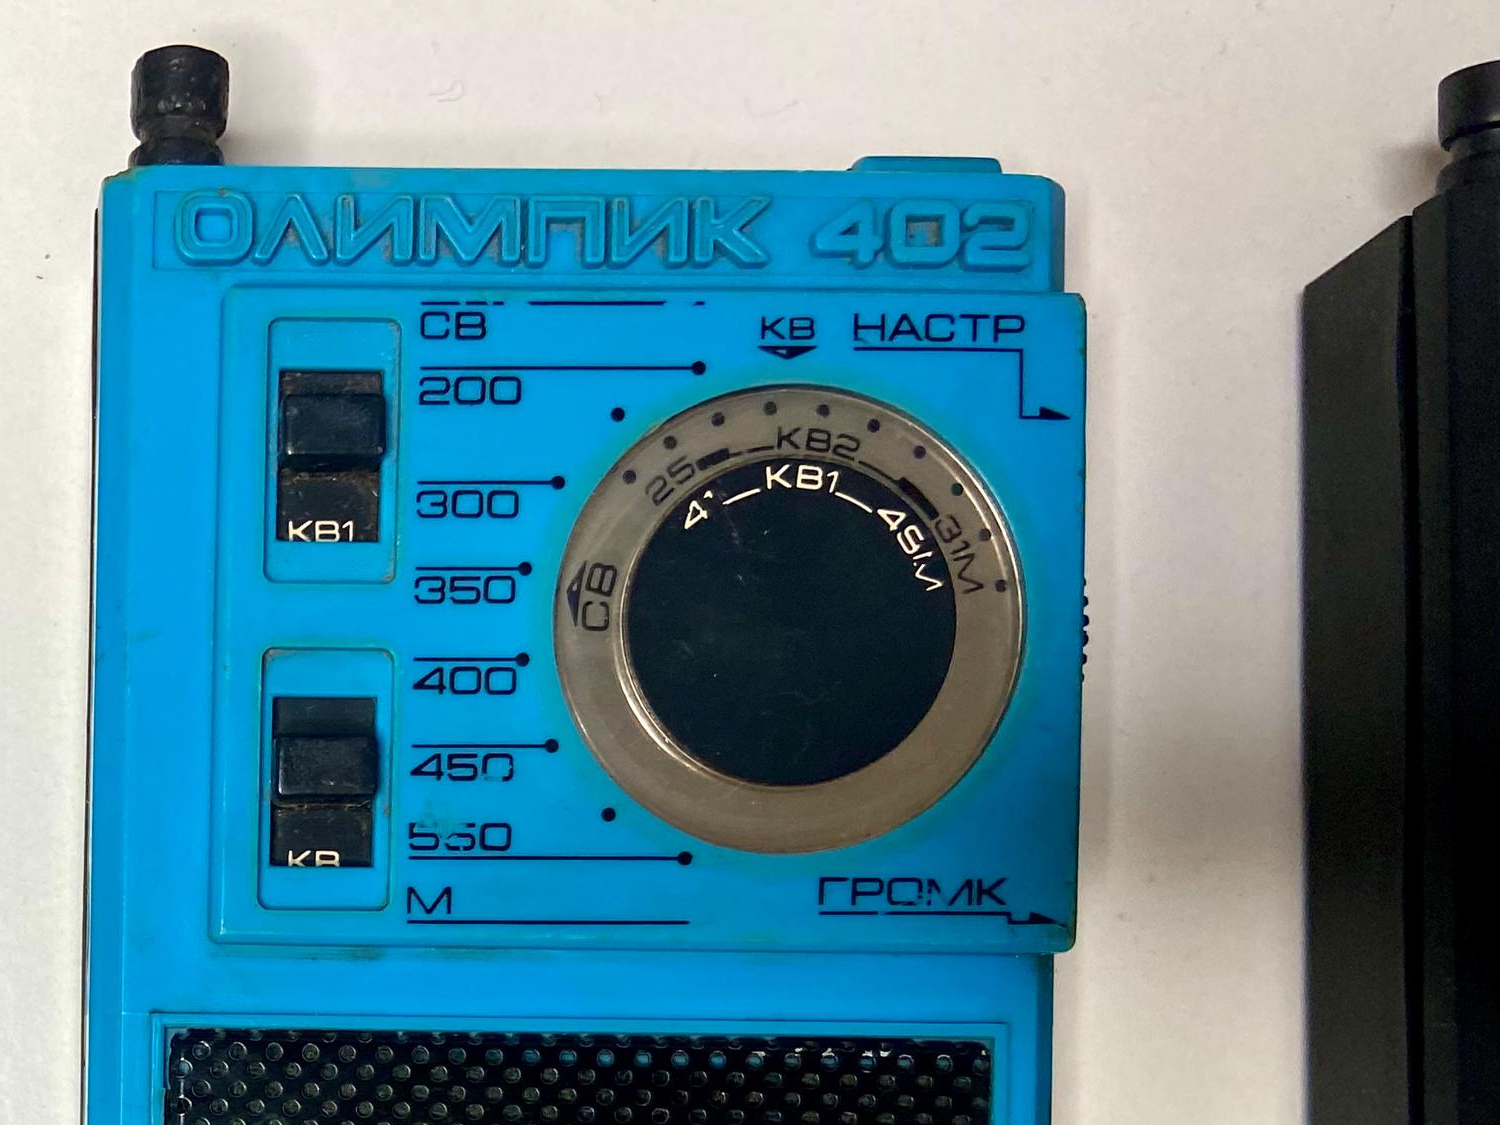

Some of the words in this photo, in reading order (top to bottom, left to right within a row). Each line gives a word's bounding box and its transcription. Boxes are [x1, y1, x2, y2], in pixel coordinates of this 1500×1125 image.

[174, 189, 773, 268] ОЛИМПИК
[810, 199, 1033, 272] 402
[420, 311, 487, 340] СВ
[761, 317, 816, 340] КВ
[854, 313, 1026, 342] НАСТР
[419, 376, 522, 405] 200
[417, 490, 519, 519] 300
[414, 576, 516, 604] 350
[413, 667, 517, 695] 400
[410, 753, 514, 782] 450
[406, 886, 452, 914] М
[818, 877, 1008, 906] ГРОМК
